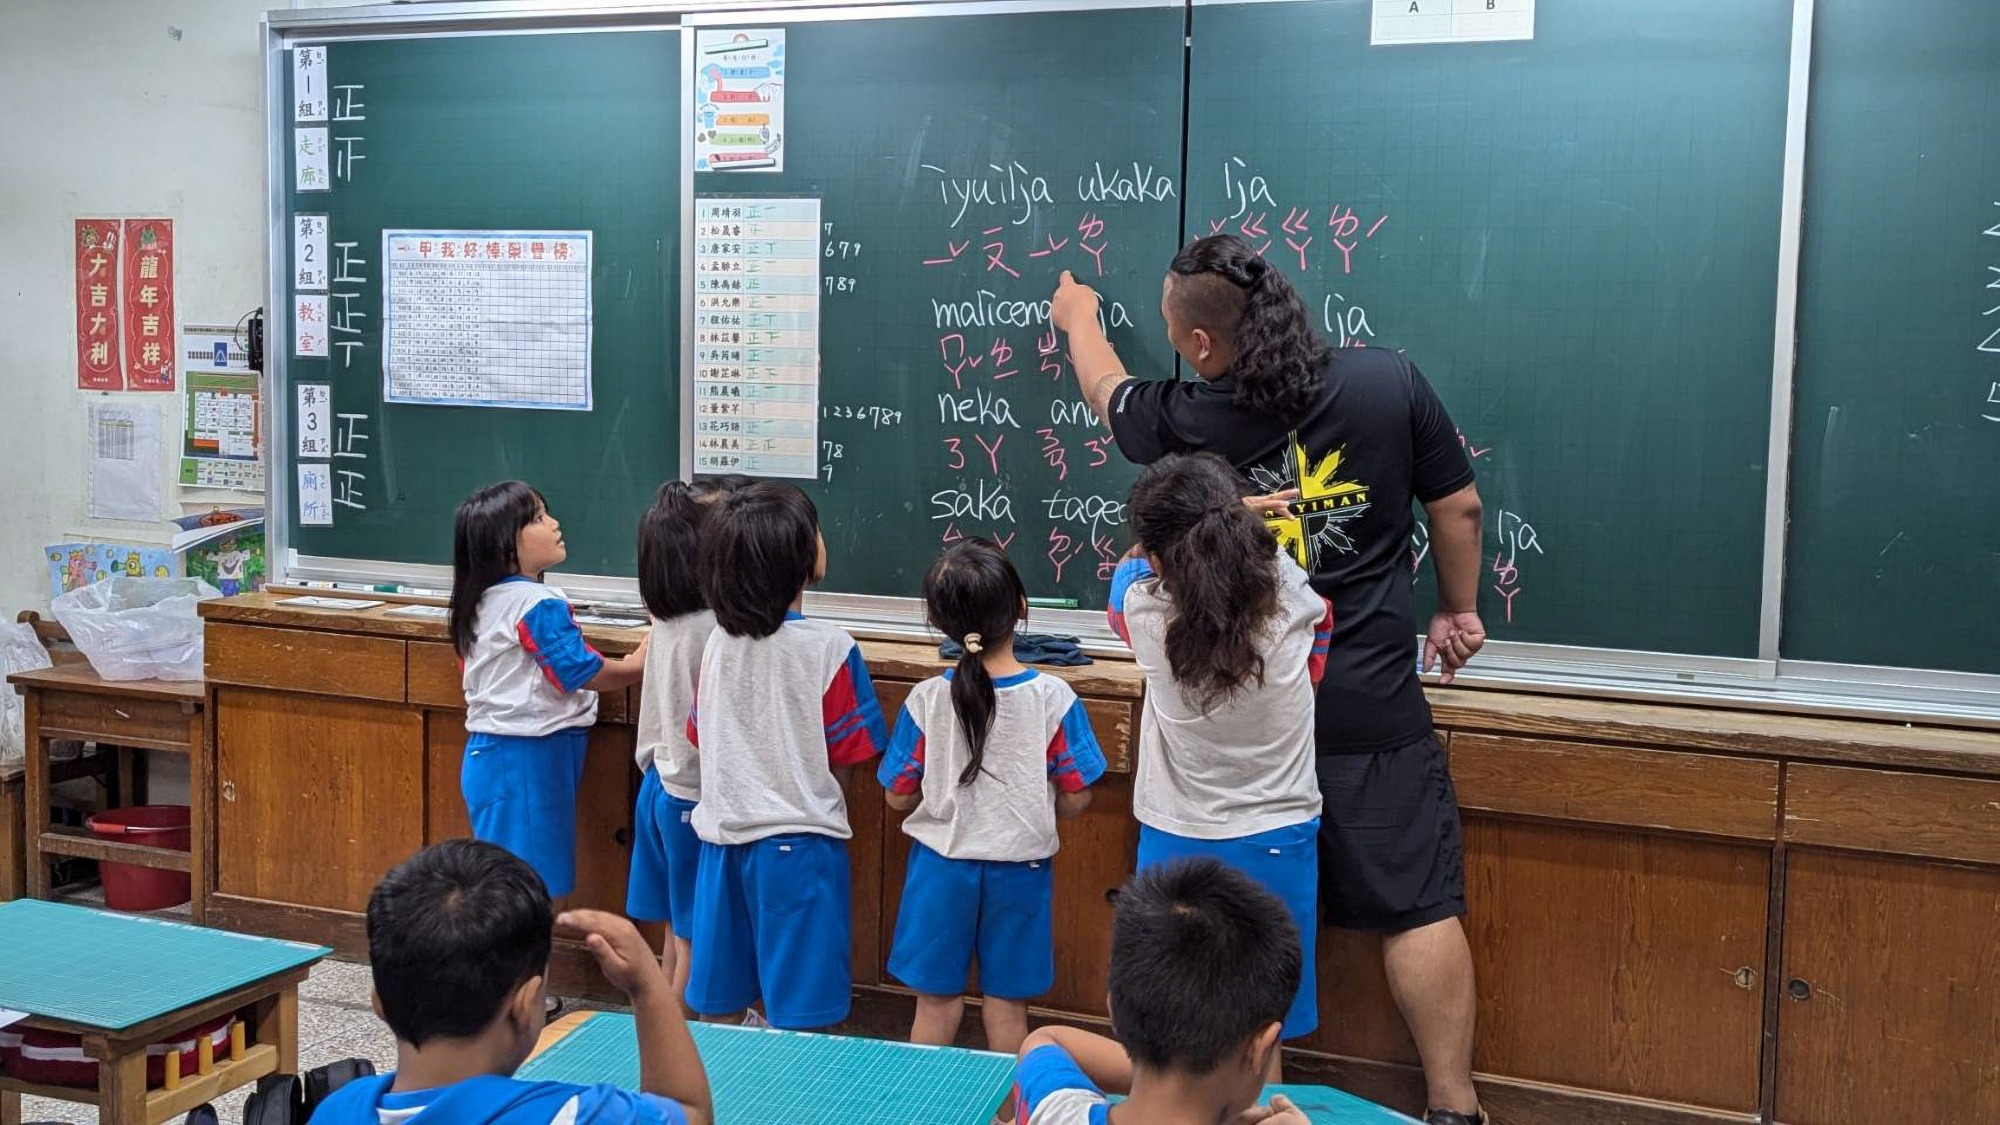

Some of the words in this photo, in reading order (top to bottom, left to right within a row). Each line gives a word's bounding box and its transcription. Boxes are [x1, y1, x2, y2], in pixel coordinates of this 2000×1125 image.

[1408, 1, 1419, 13] A
[1486, 0, 1496, 10] B
[89, 253, 108, 366] 大吉大利
[139, 255, 161, 366] 龍年吉祥
[298, 302, 316, 352] 教室
